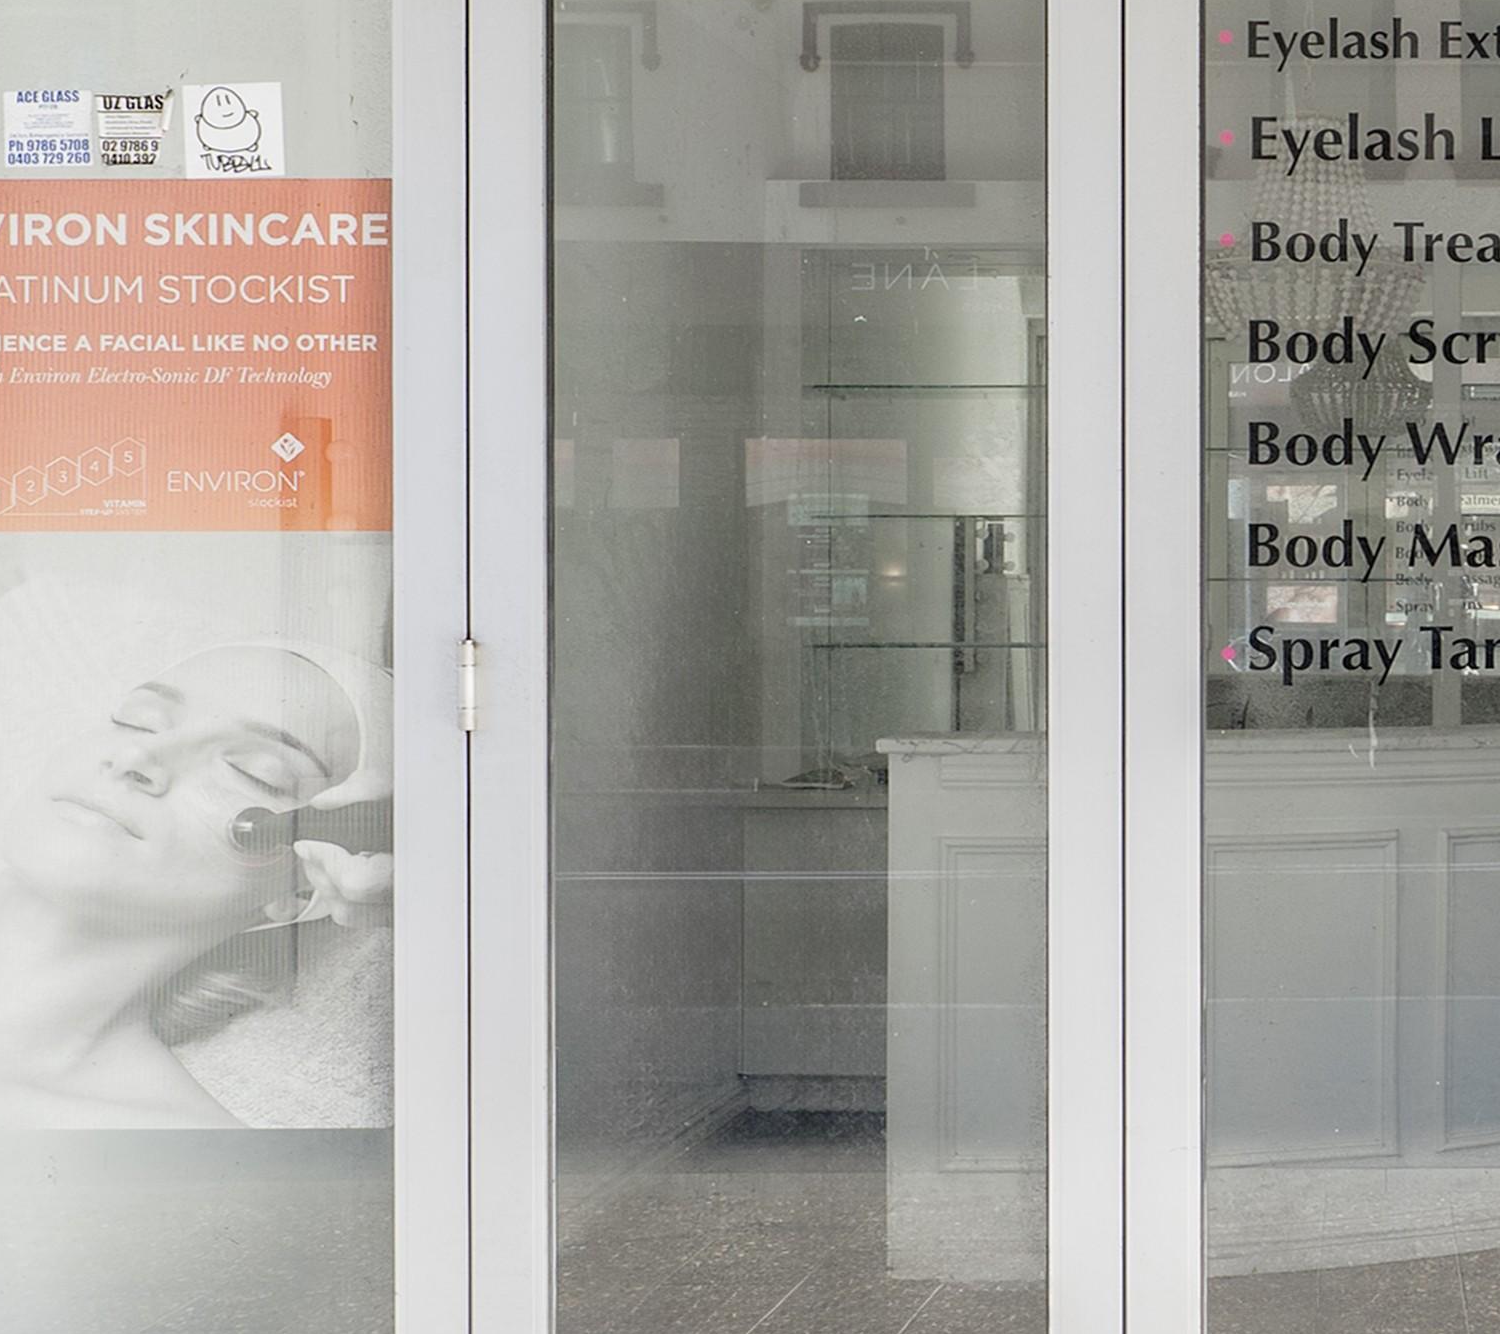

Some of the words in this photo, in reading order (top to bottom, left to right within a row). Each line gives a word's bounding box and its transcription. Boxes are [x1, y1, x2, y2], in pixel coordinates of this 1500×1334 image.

[1247, 18, 1420, 72] Eyelash
[16, 90, 39, 104] ACE
[42, 90, 80, 103] GLASS
[8, 153, 39, 165] 0403
[43, 153, 64, 165] 729
[68, 153, 91, 164] 260
[9, 139, 23, 152] Ph
[27, 139, 56, 152] 9786
[60, 139, 89, 151] 5708
[102, 140, 117, 152] 02
[120, 140, 148, 152] 9786
[1251, 113, 1455, 176] Eyelash
[144, 213, 389, 247] SKINCARE
[1251, 218, 1378, 277] Body
[158, 275, 356, 304] STOCKIST
[75, 334, 92, 352] A
[100, 334, 185, 352] FACIAL
[193, 334, 245, 352] LIKE
[254, 334, 290, 352] NO
[297, 334, 378, 352] OTHER
[1248, 317, 1386, 379] Body
[10, 367, 81, 384] Environ
[87, 367, 199, 384] Electro-Sonic
[204, 368, 232, 384] DF
[237, 367, 333, 388] Technology
[1248, 418, 1386, 482] Body
[167, 470, 299, 492] ENVIRON
[248, 497, 299, 508] stockist
[1248, 519, 1386, 584] Body
[1248, 625, 1403, 686] Spray
